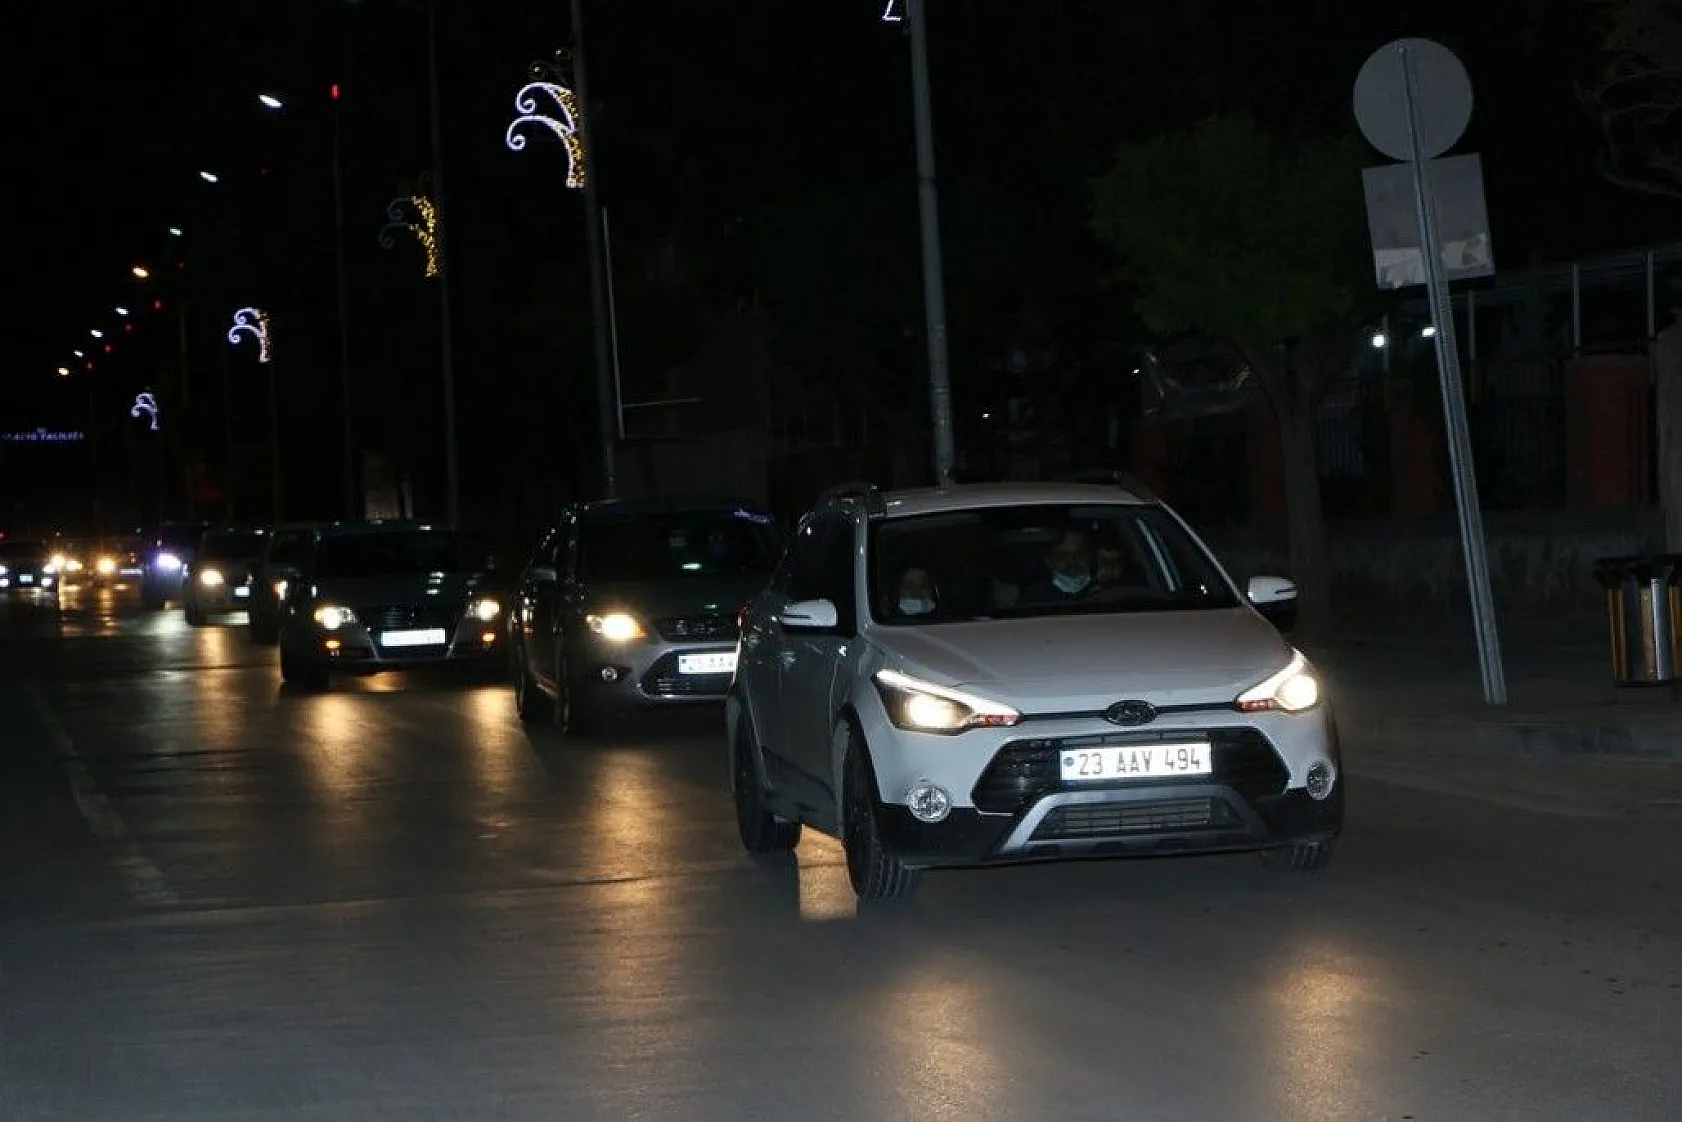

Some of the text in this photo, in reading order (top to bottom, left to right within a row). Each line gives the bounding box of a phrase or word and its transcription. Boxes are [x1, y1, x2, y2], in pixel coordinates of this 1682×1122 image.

[1079, 747, 1201, 775] 23 AAV 494
